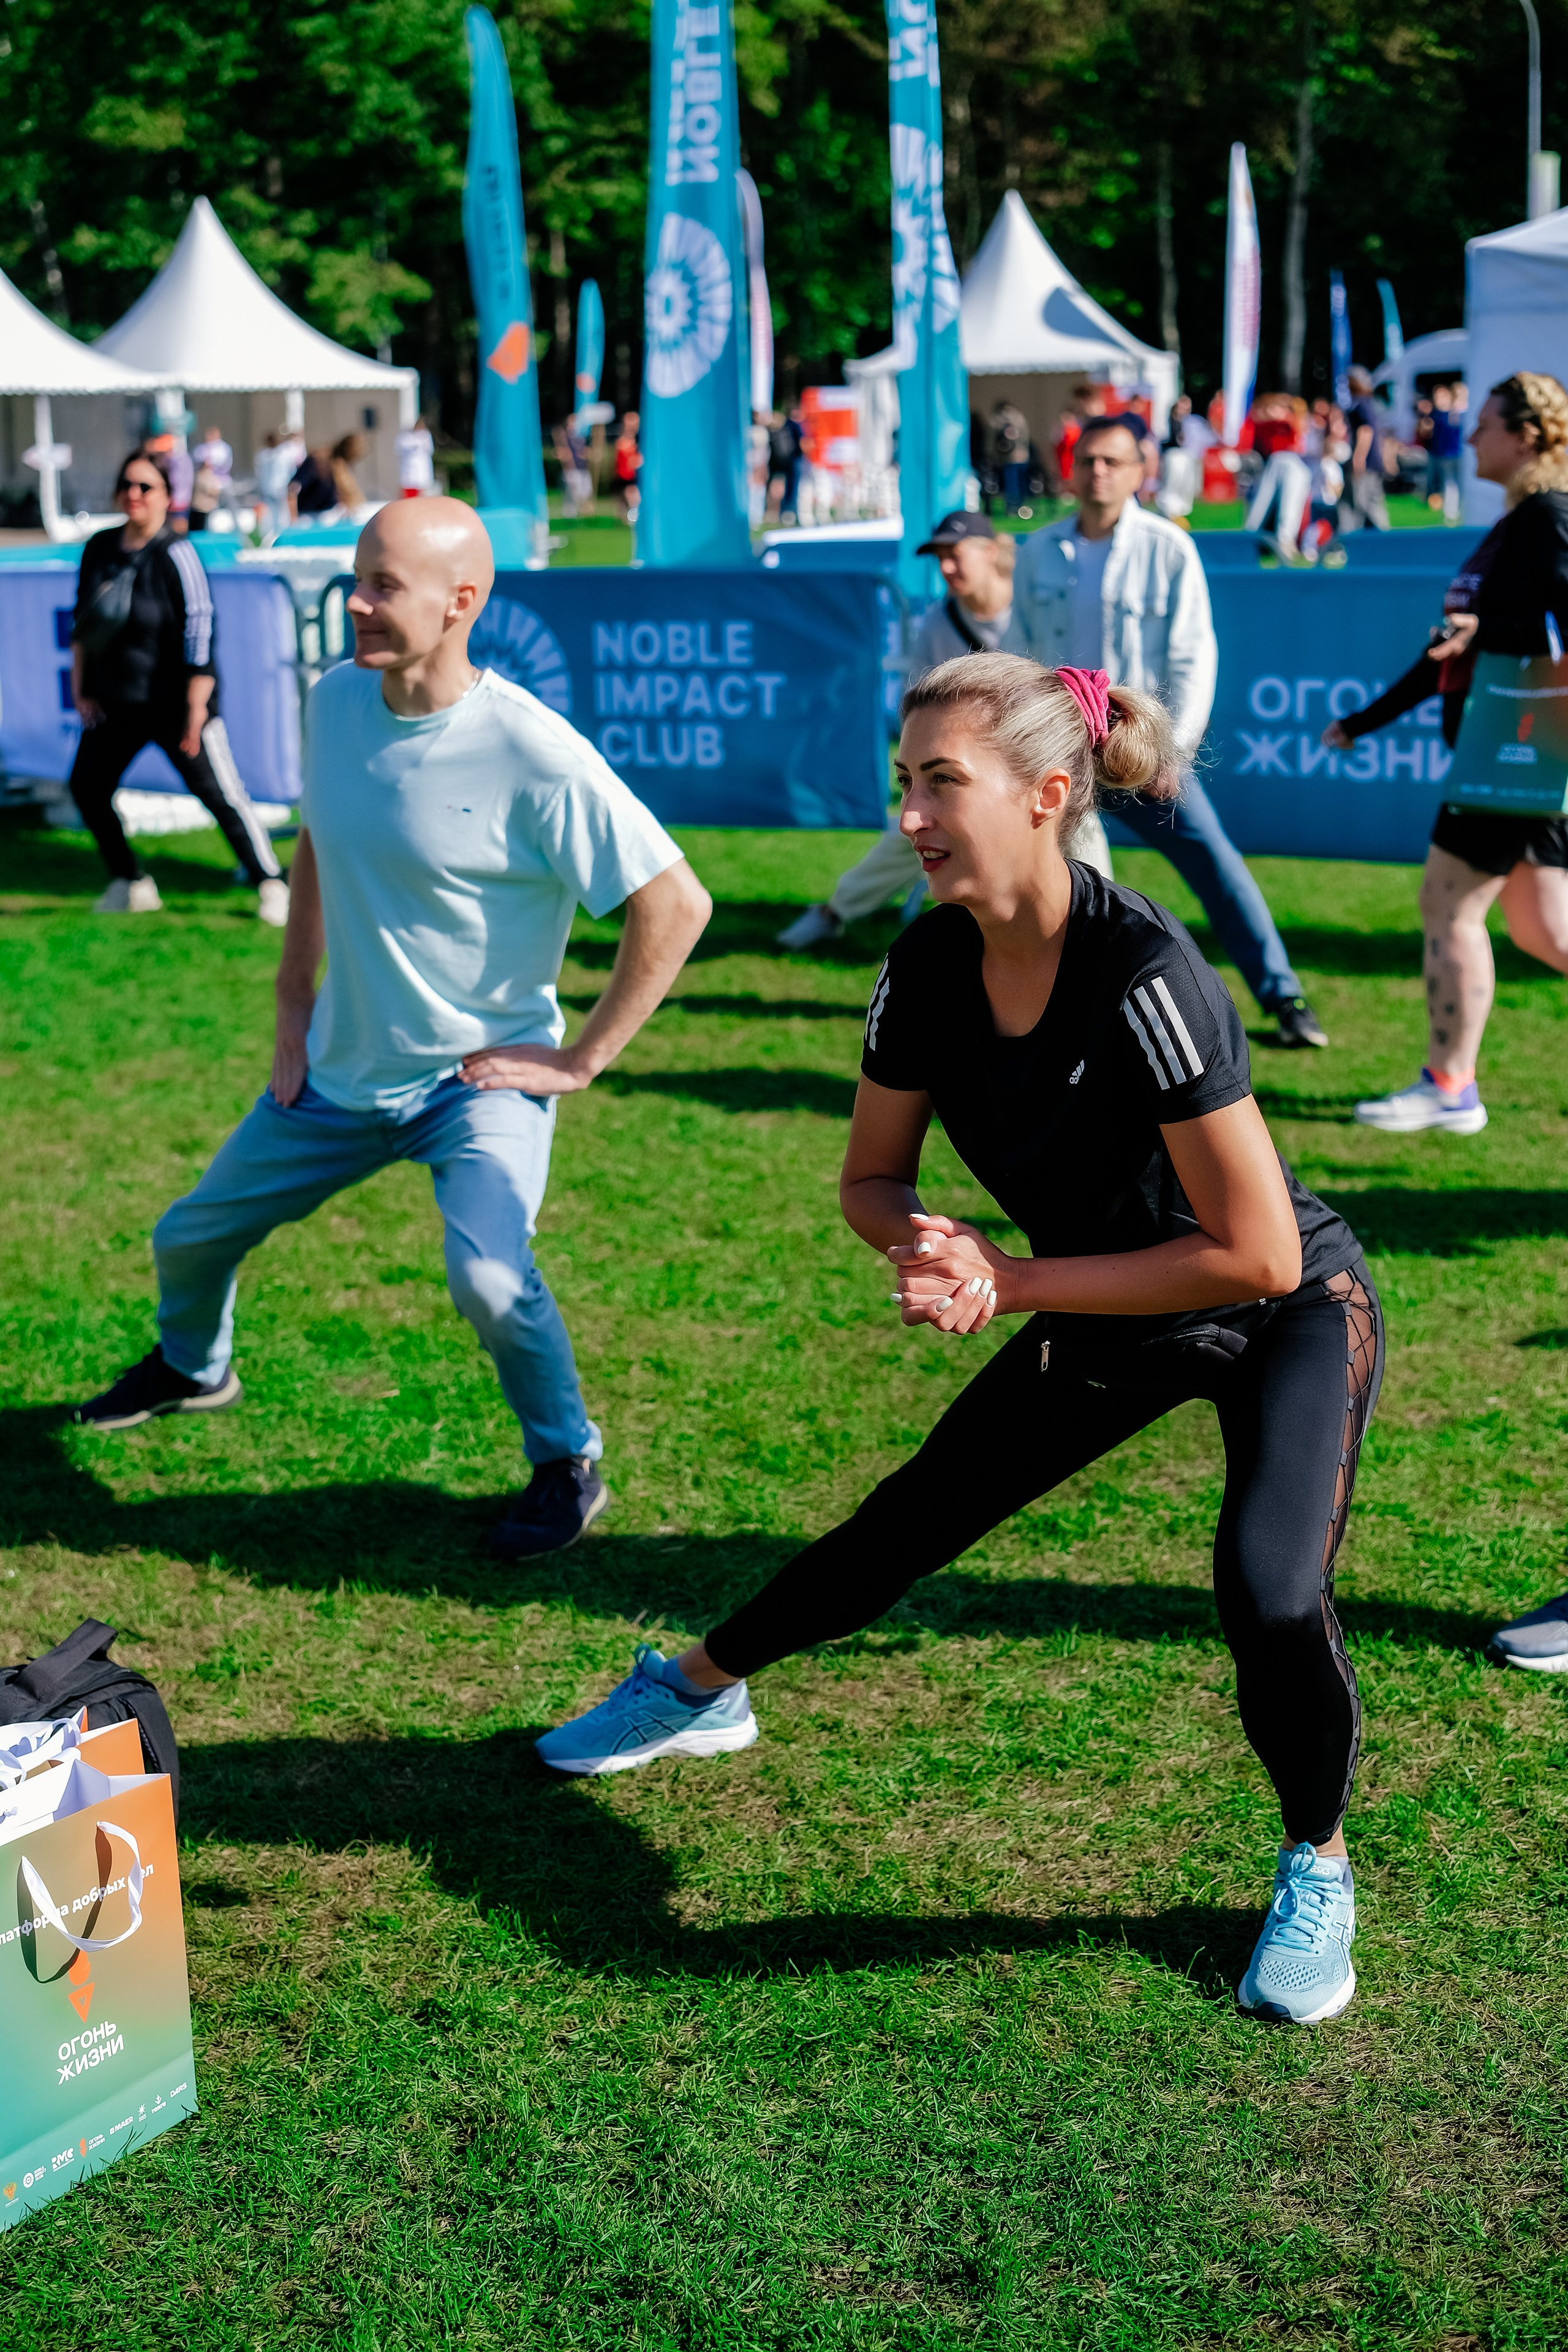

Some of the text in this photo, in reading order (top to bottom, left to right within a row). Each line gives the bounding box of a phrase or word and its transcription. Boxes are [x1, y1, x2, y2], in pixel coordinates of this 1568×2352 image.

[595, 622, 751, 665] NOBLE
[598, 674, 783, 717] IMPACT
[600, 724, 723, 766] CLUB
[72, 1877, 126, 1913] добрых
[56, 2034, 124, 2086] ЖИЗНИ
[58, 2021, 117, 2061] ОГОНЬ
[170, 2082, 187, 2098] DARS
[88, 2134, 104, 2145] ОГОНЬ
[115, 2116, 134, 2132] MAER
